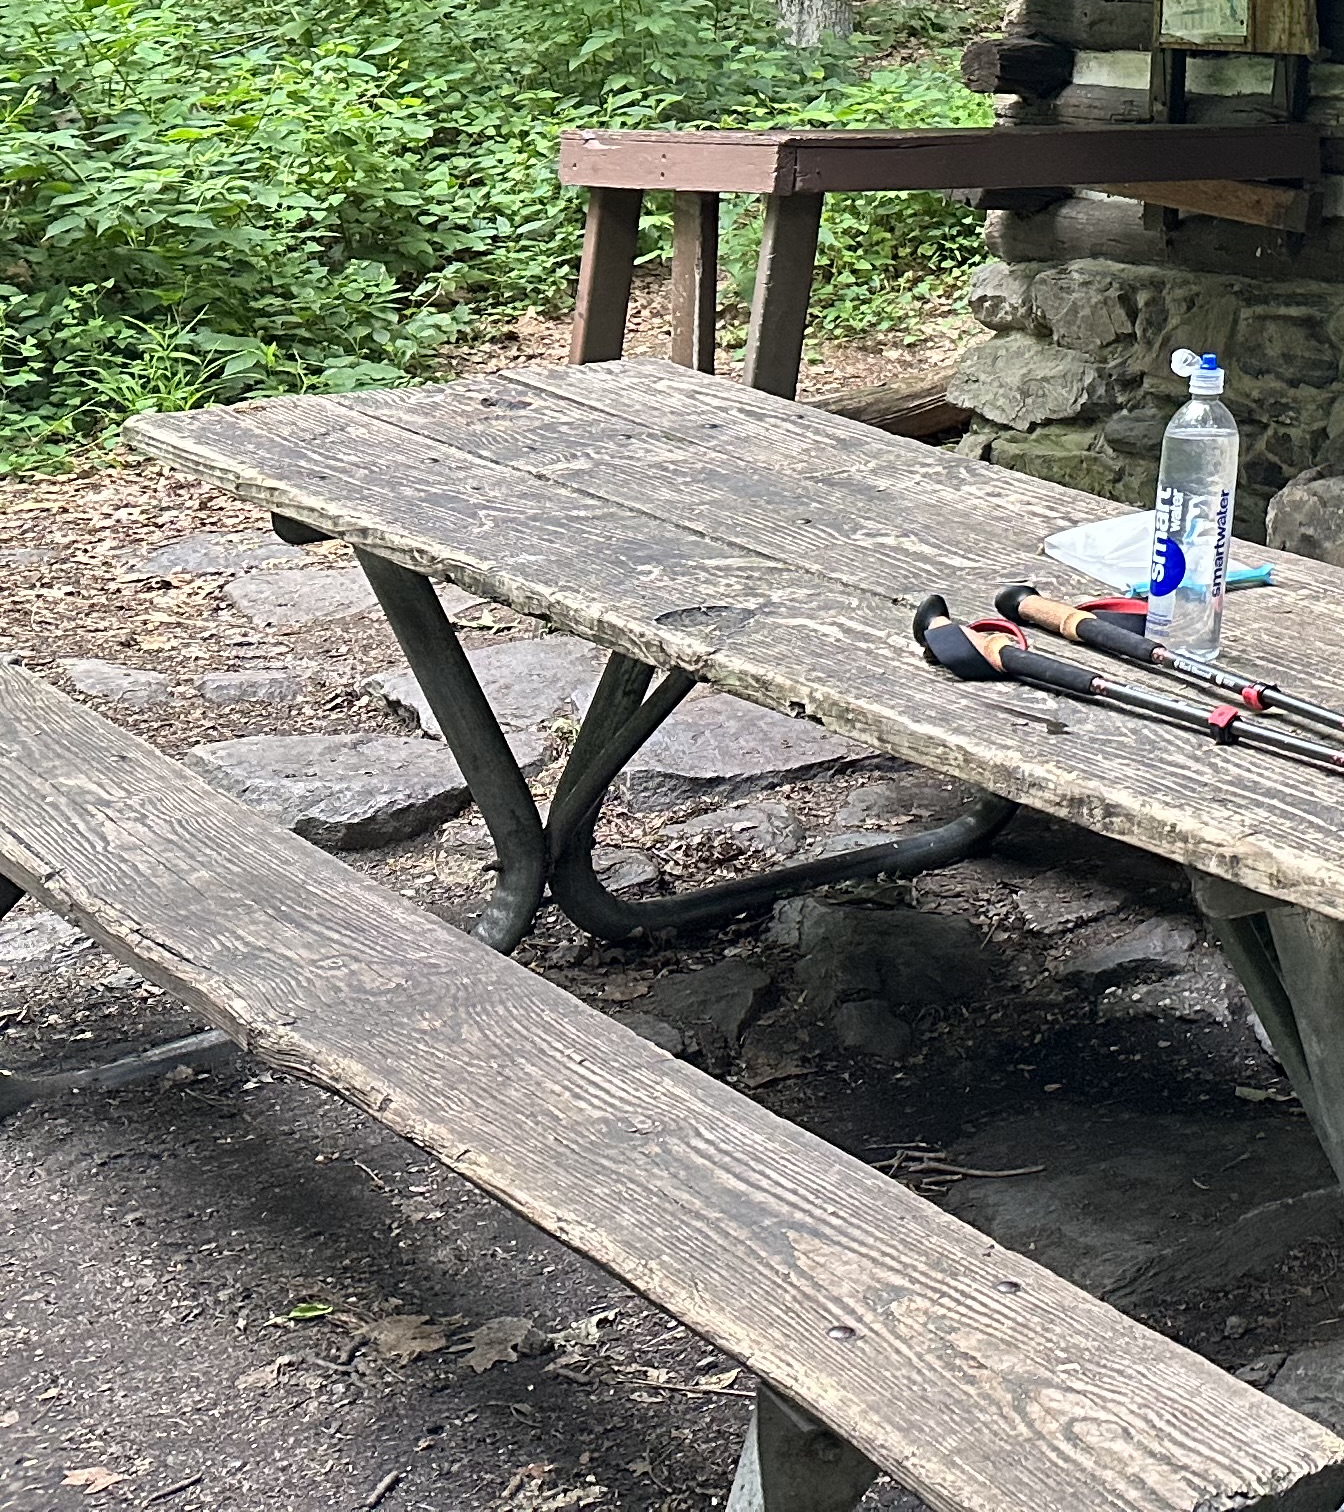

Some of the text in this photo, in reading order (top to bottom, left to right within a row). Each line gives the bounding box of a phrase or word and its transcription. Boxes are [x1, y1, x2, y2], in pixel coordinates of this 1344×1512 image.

[1150, 485, 1172, 584] smart
[1169, 487, 1185, 533] water
[1211, 489, 1231, 598] smartwater
